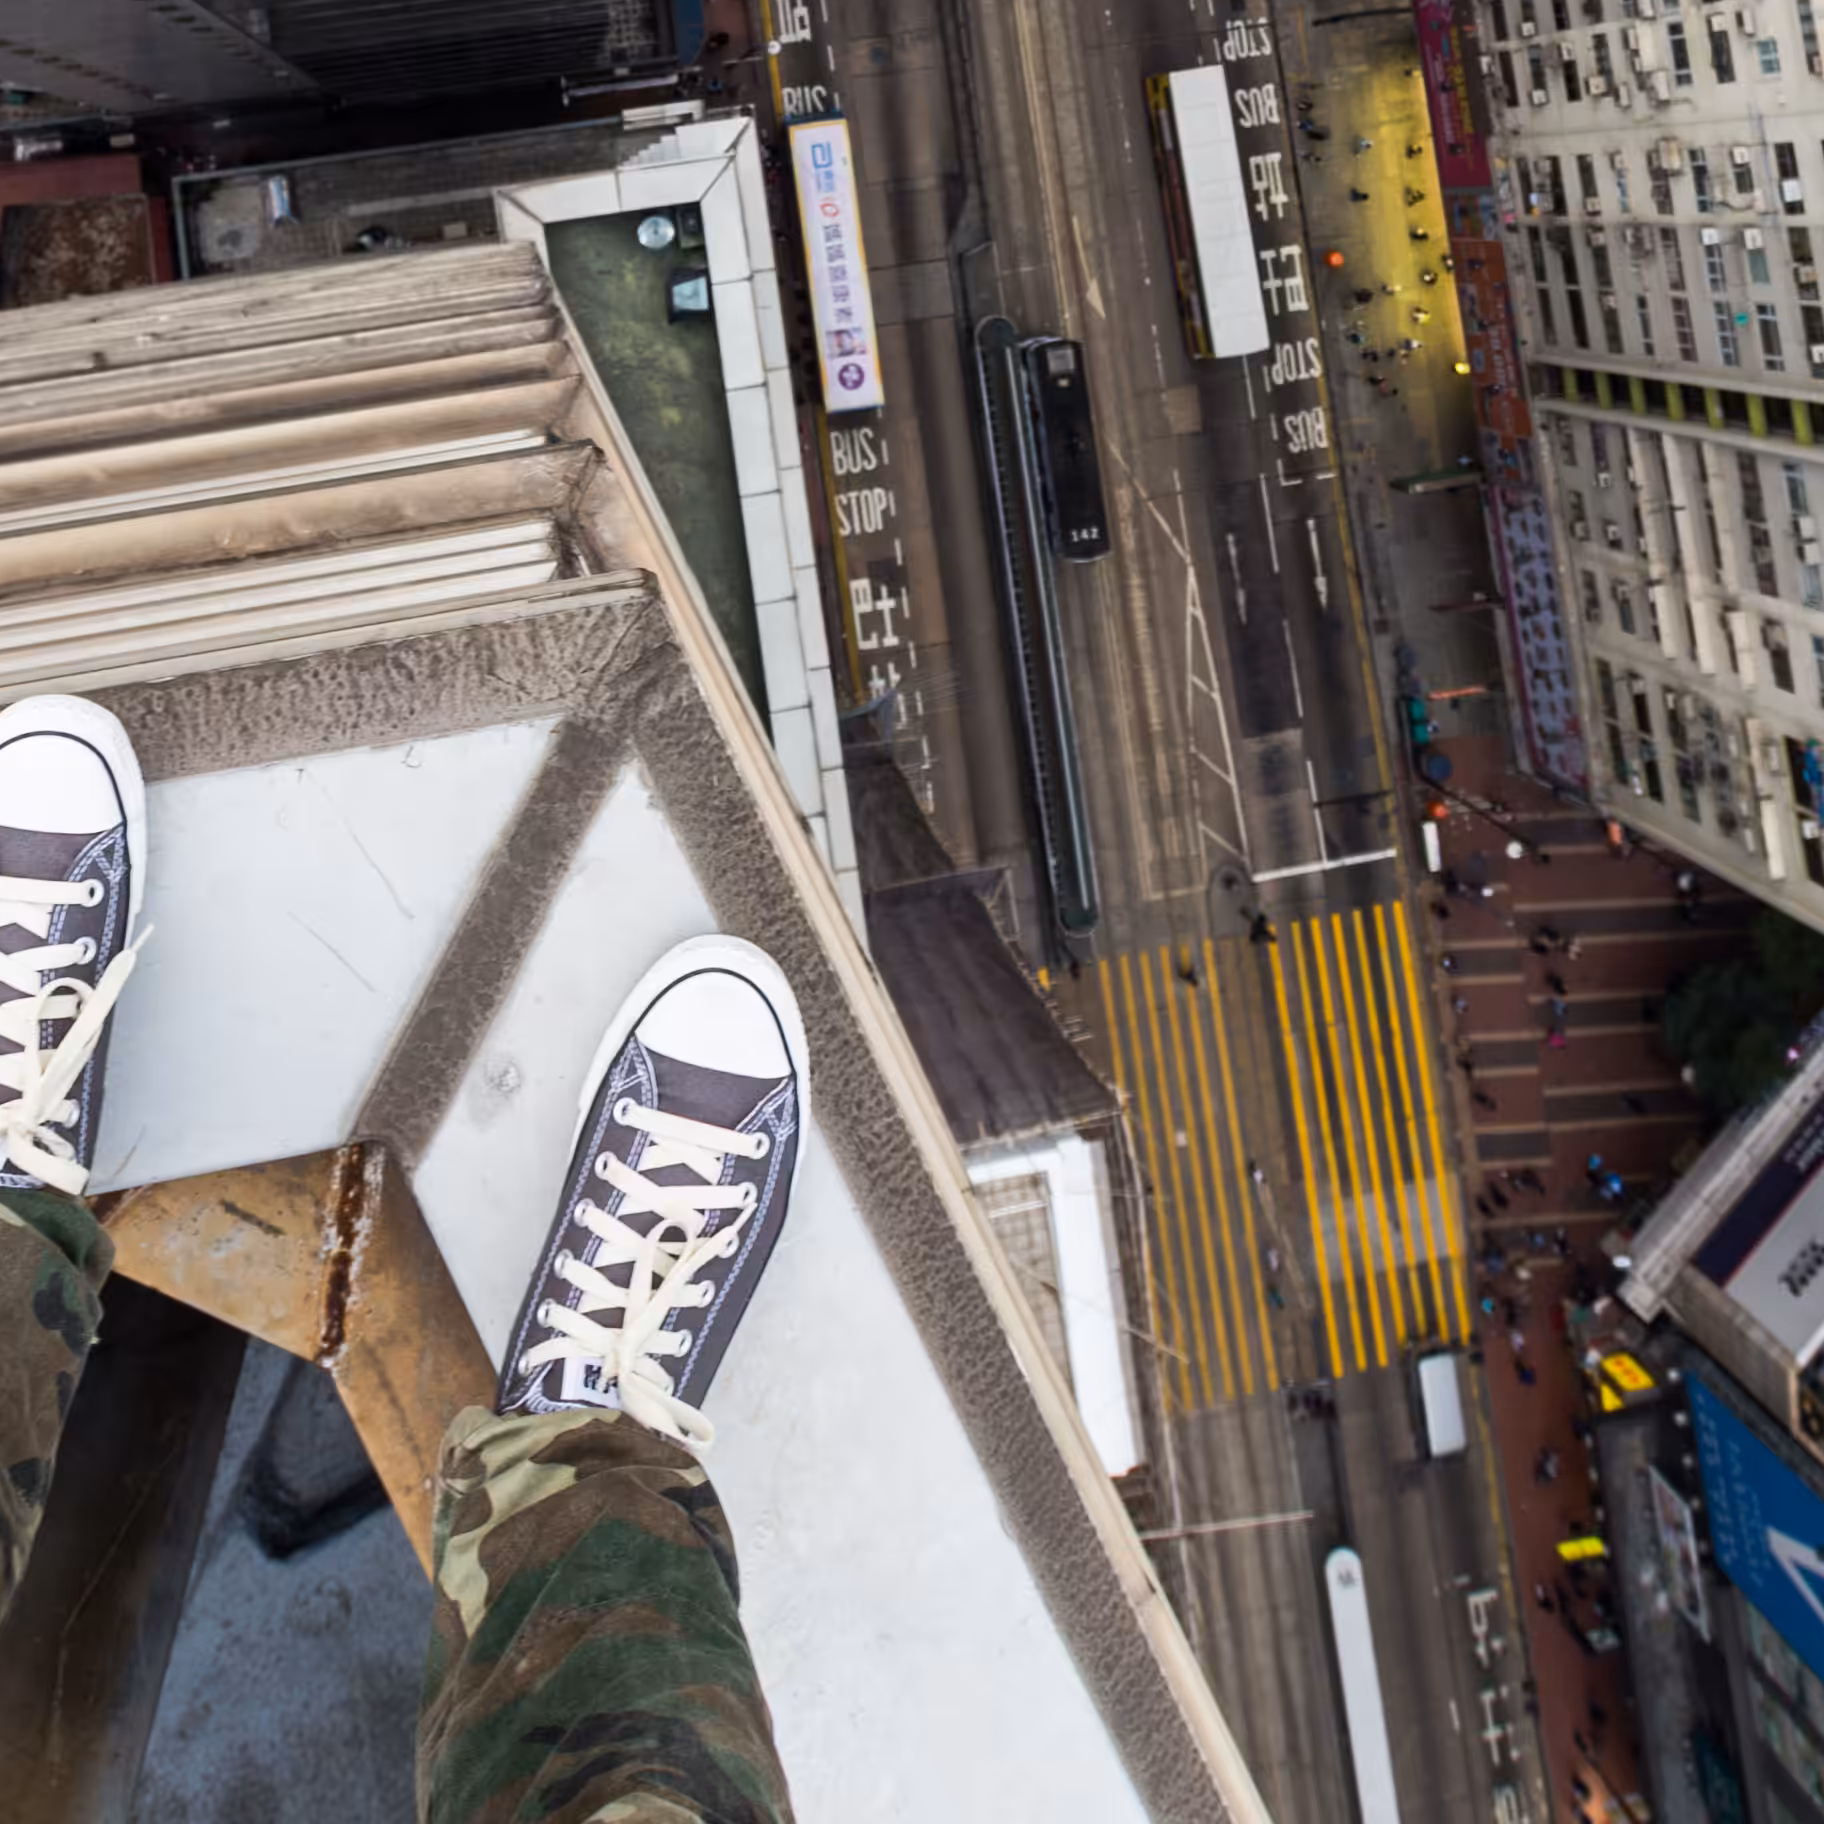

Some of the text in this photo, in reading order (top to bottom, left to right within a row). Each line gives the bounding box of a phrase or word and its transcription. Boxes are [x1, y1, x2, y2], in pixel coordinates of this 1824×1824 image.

[1223, 17, 1272, 61] STOP
[1235, 83, 1280, 128] BUS
[1249, 152, 1289, 221] 站
[1260, 244, 1309, 316] 巴士
[1272, 337, 1322, 385] STOP
[830, 427, 877, 475] BUS
[1284, 407, 1328, 453] BUS
[835, 488, 888, 536] STOP
[1071, 528, 1100, 543] 142
[849, 579, 899, 650] 巴士
